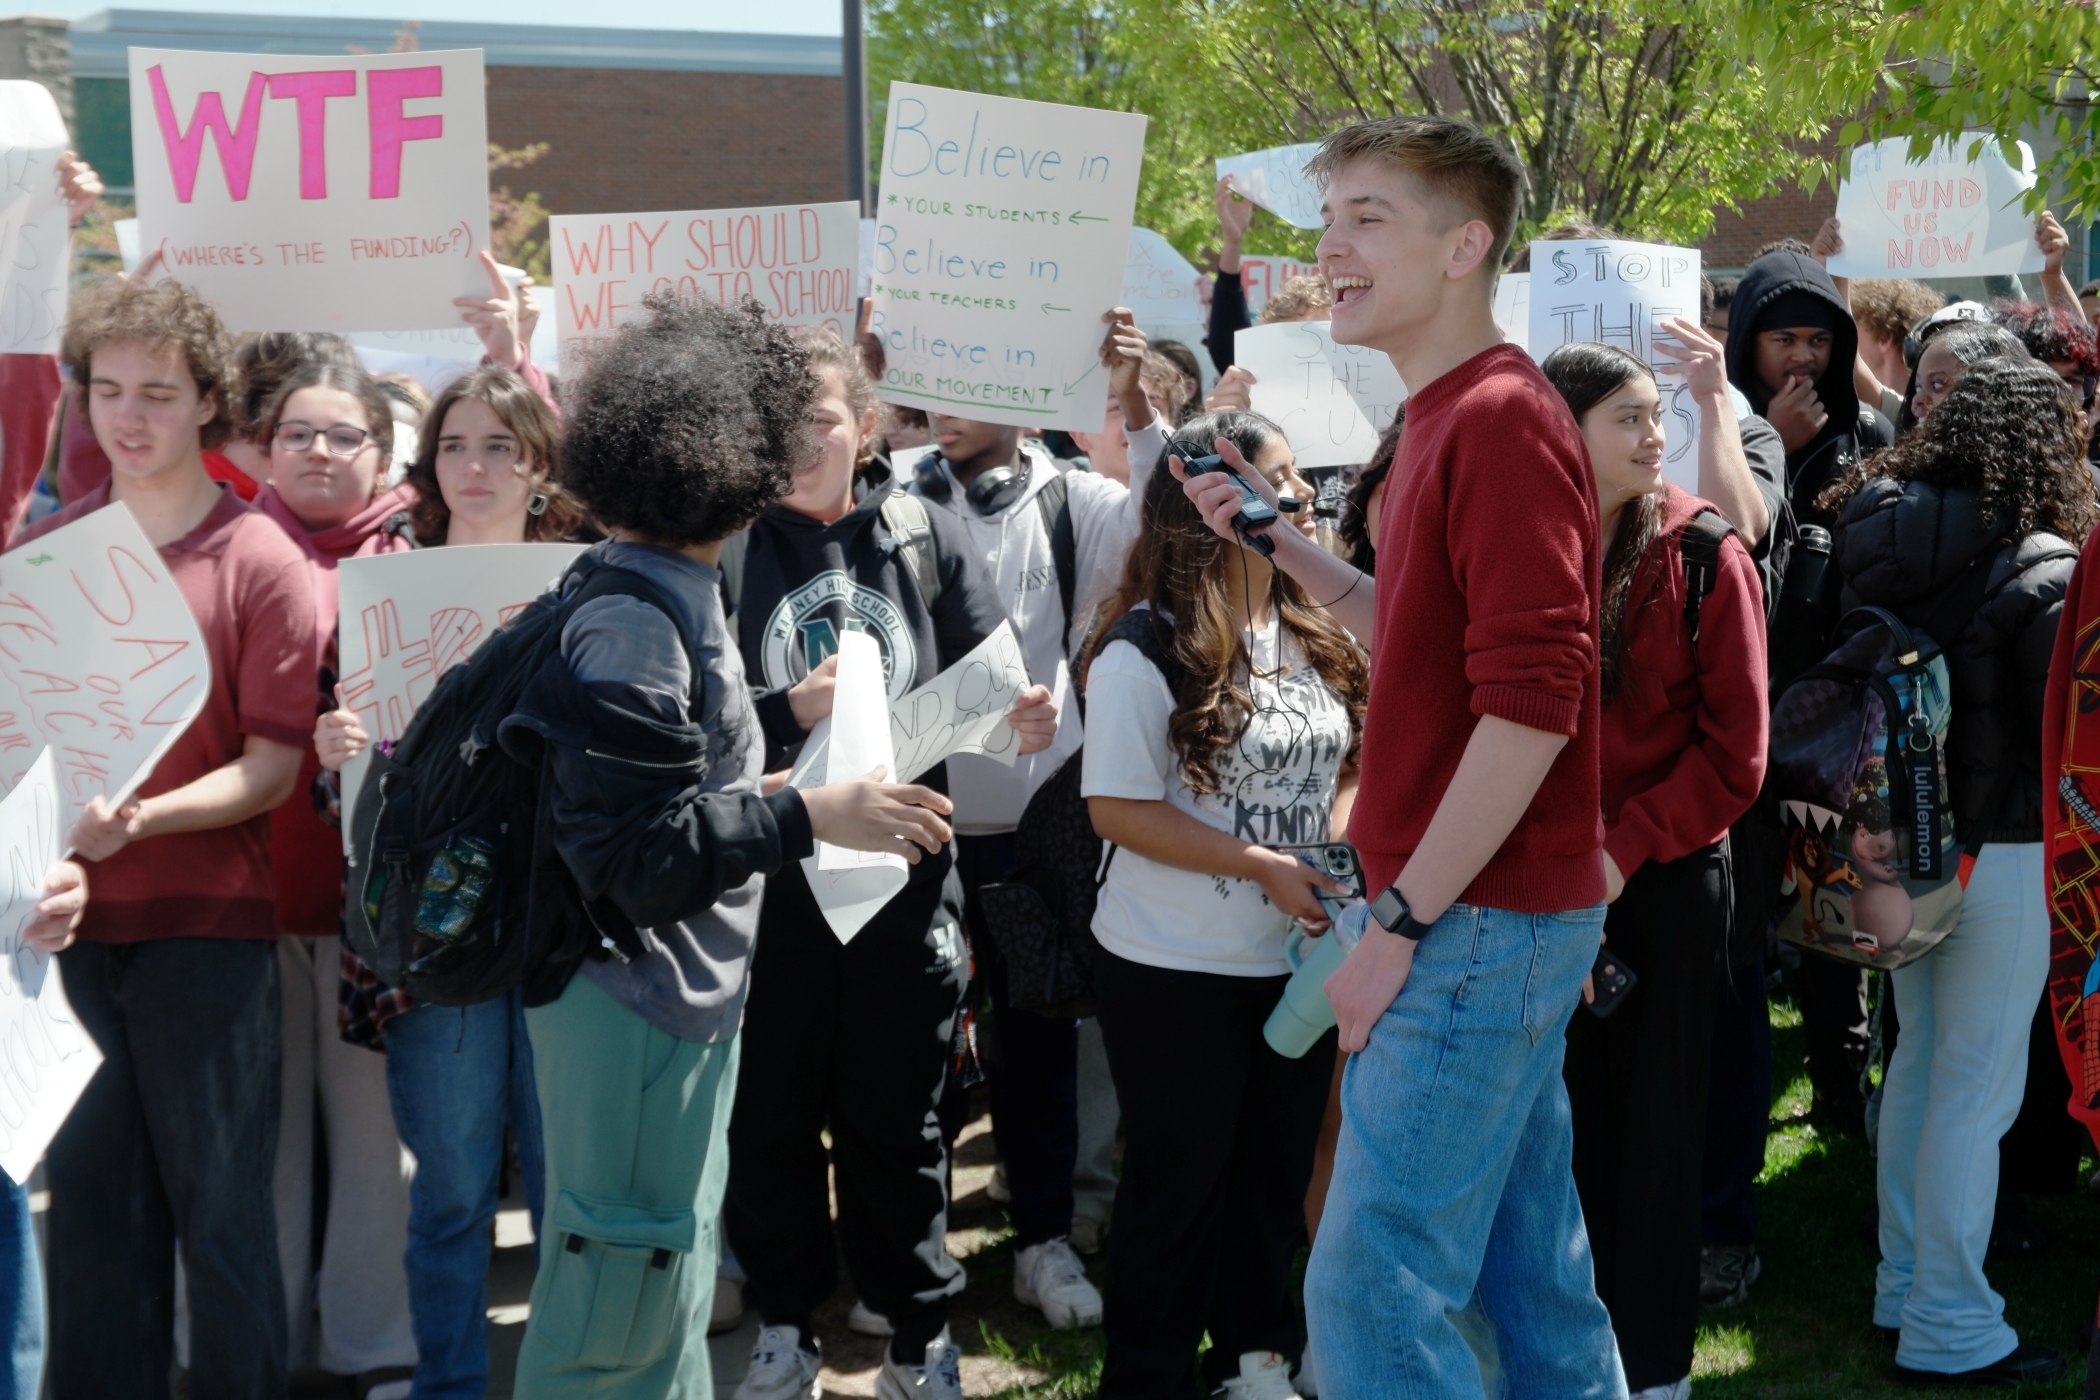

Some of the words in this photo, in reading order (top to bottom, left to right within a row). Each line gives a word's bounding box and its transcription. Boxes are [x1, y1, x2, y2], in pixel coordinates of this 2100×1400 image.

[146, 64, 443, 203] WTF
[889, 97, 1062, 182] Believe
[1078, 150, 1110, 183] in
[903, 195, 954, 217] YOUR
[964, 203, 1062, 226] STUDENTS
[1886, 176, 1982, 211] FUND
[274, 241, 326, 266] THE
[349, 220, 473, 261] FUNDING?)
[561, 219, 670, 276] WHY
[684, 208, 822, 272] SHOULD
[1886, 231, 1975, 270] NOW
[1902, 211, 1939, 236] US
[874, 223, 1007, 279] Believe
[1028, 257, 1060, 284] in
[1551, 245, 1690, 289] STOP
[565, 279, 630, 331] WE
[766, 267, 856, 320] SCHOOL
[887, 287, 922, 302] YOUR
[928, 291, 1018, 312] TEACHERS
[872, 310, 988, 364] Believe
[1005, 344, 1037, 369] in
[1549, 301, 1684, 372] THE
[936, 377, 1056, 405] MOVEMENT
[1295, 360, 1373, 401] THE
[772, 586, 821, 642] MANEY
[850, 590, 901, 638] SCHOOL
[0, 591, 111, 809] TEACHE
[955, 633, 1024, 712] OUR
[84, 674, 136, 742] OUR
[1260, 729, 1341, 770] WITH
[1913, 765, 1935, 872] lululemon
